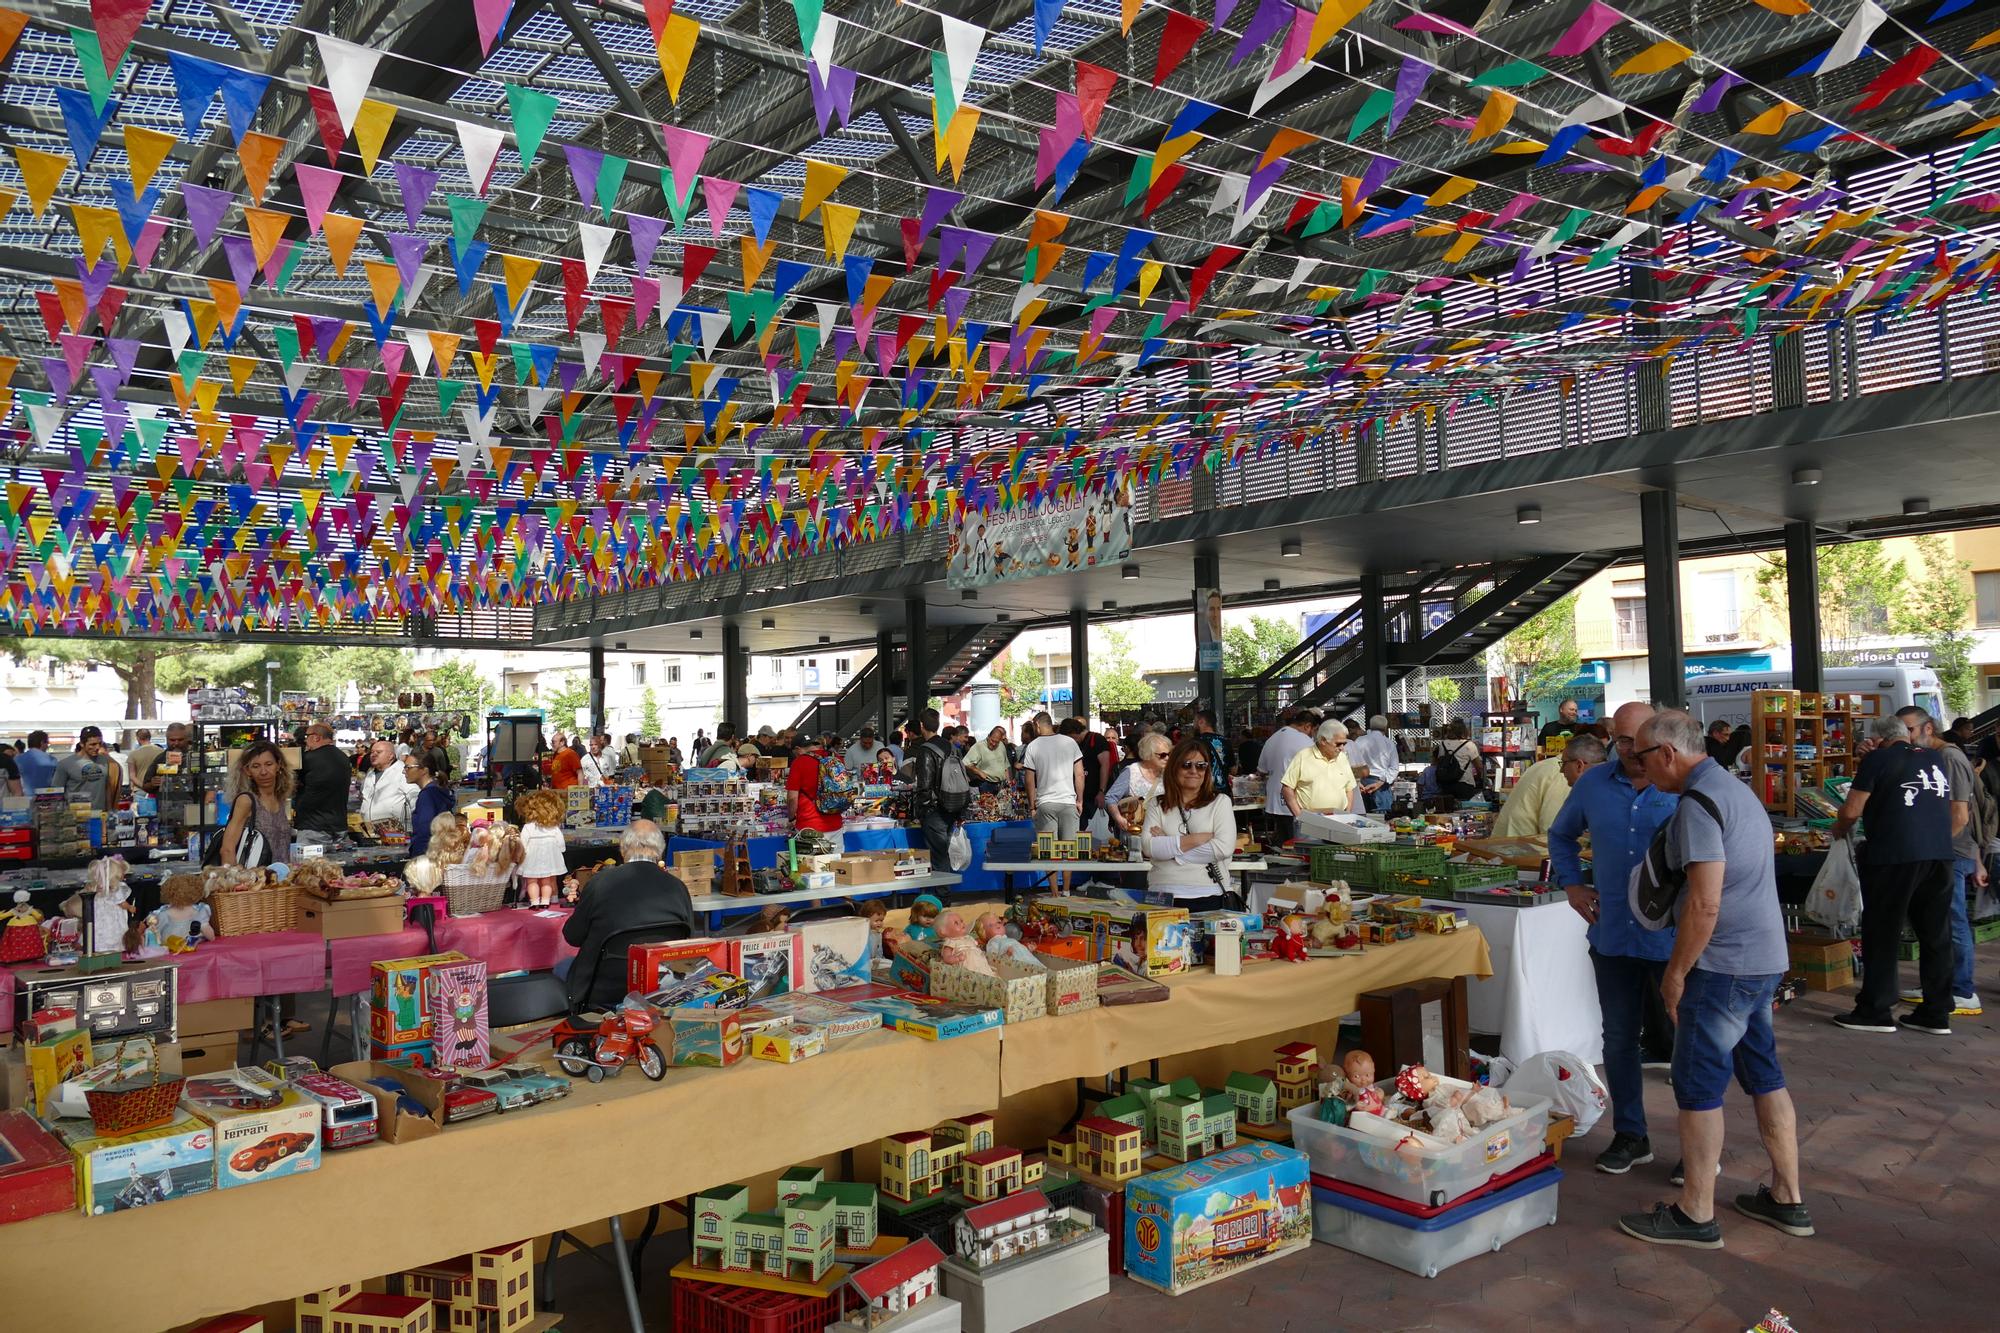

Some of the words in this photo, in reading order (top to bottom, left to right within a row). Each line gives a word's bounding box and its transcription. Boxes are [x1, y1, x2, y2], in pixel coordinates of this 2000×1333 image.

[986, 511, 1018, 527] FESTA
[1020, 507, 1039, 520] DEL
[1040, 496, 1088, 516] JOGUET
[1896, 651, 1929, 661] grau
[1685, 665, 1706, 674] MGC
[1697, 681, 1769, 695] AMBULANCIA
[742, 943, 760, 952] POLICE
[763, 941, 776, 949] AUTO
[778, 938, 792, 948] CYCLE
[984, 1011, 998, 1024] HO
[224, 1124, 269, 1140] Ferrari
